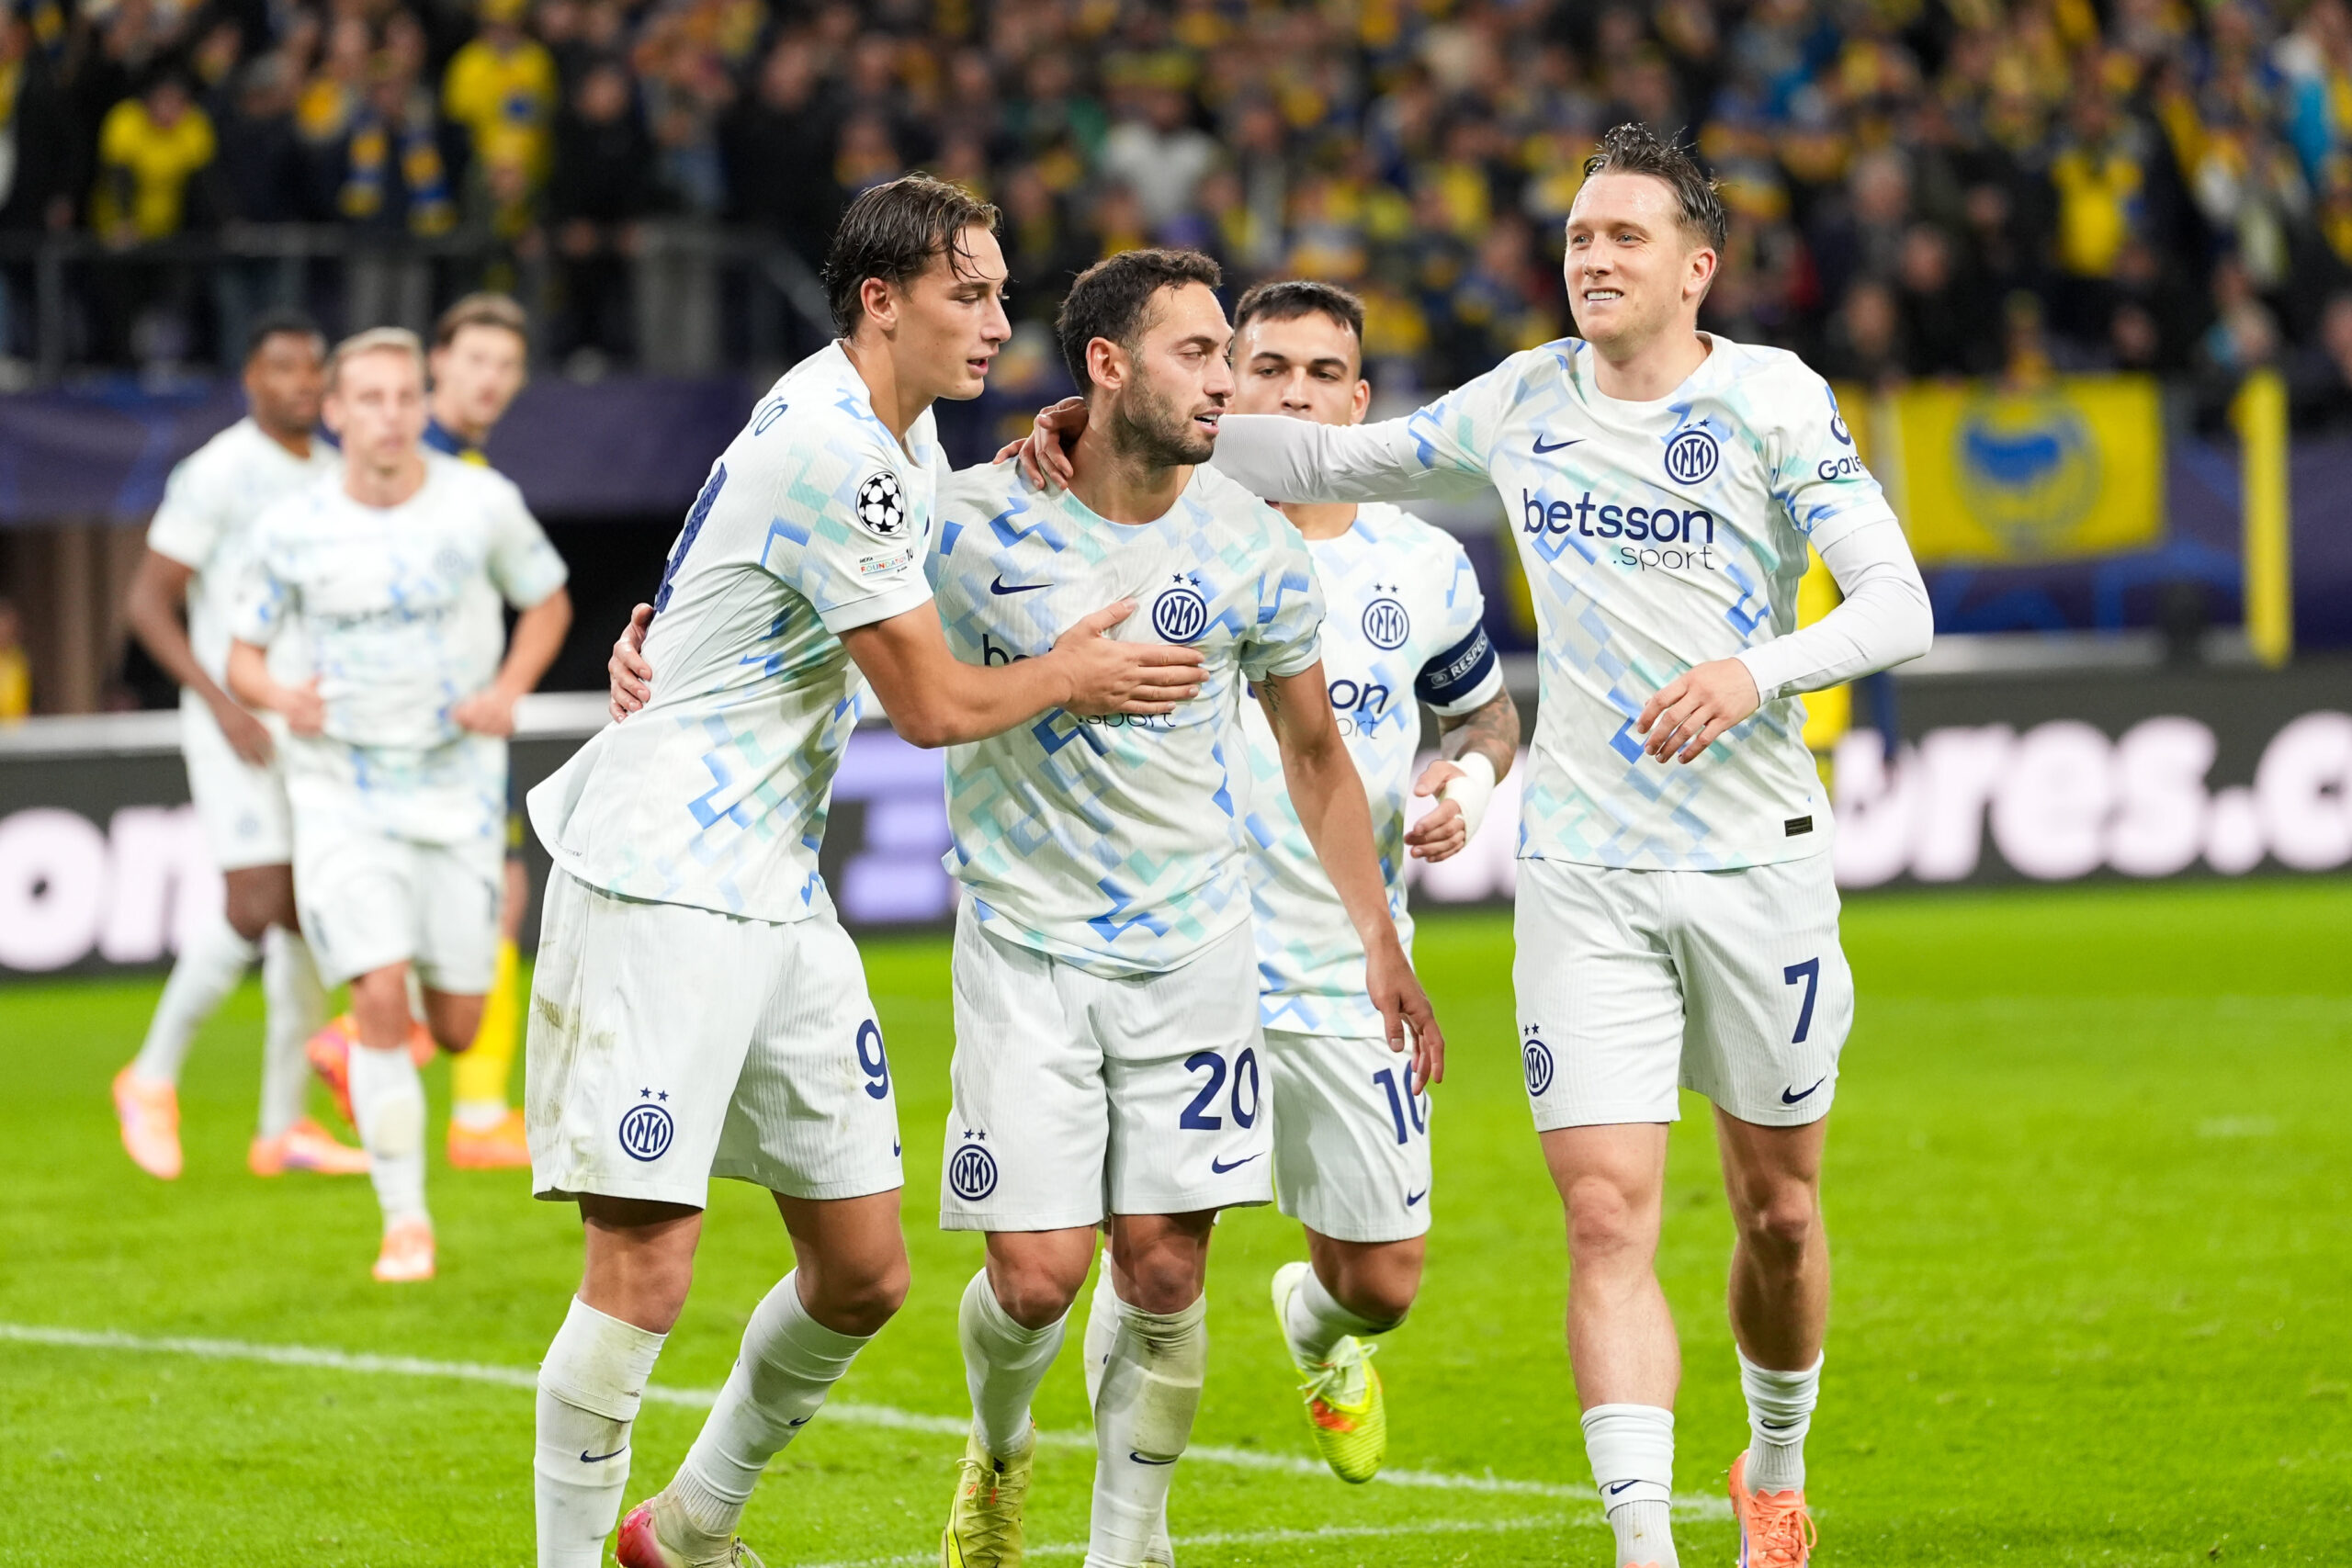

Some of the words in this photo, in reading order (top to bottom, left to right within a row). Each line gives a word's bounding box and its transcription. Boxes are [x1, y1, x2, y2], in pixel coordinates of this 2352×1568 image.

[1522, 488, 1714, 545] betsson
[1612, 546, 1715, 571] .sport
[1782, 956, 1820, 1044] 7
[855, 1018, 891, 1100] 9
[1179, 1046, 1260, 1131] 20
[1373, 1060, 1428, 1145] 10
